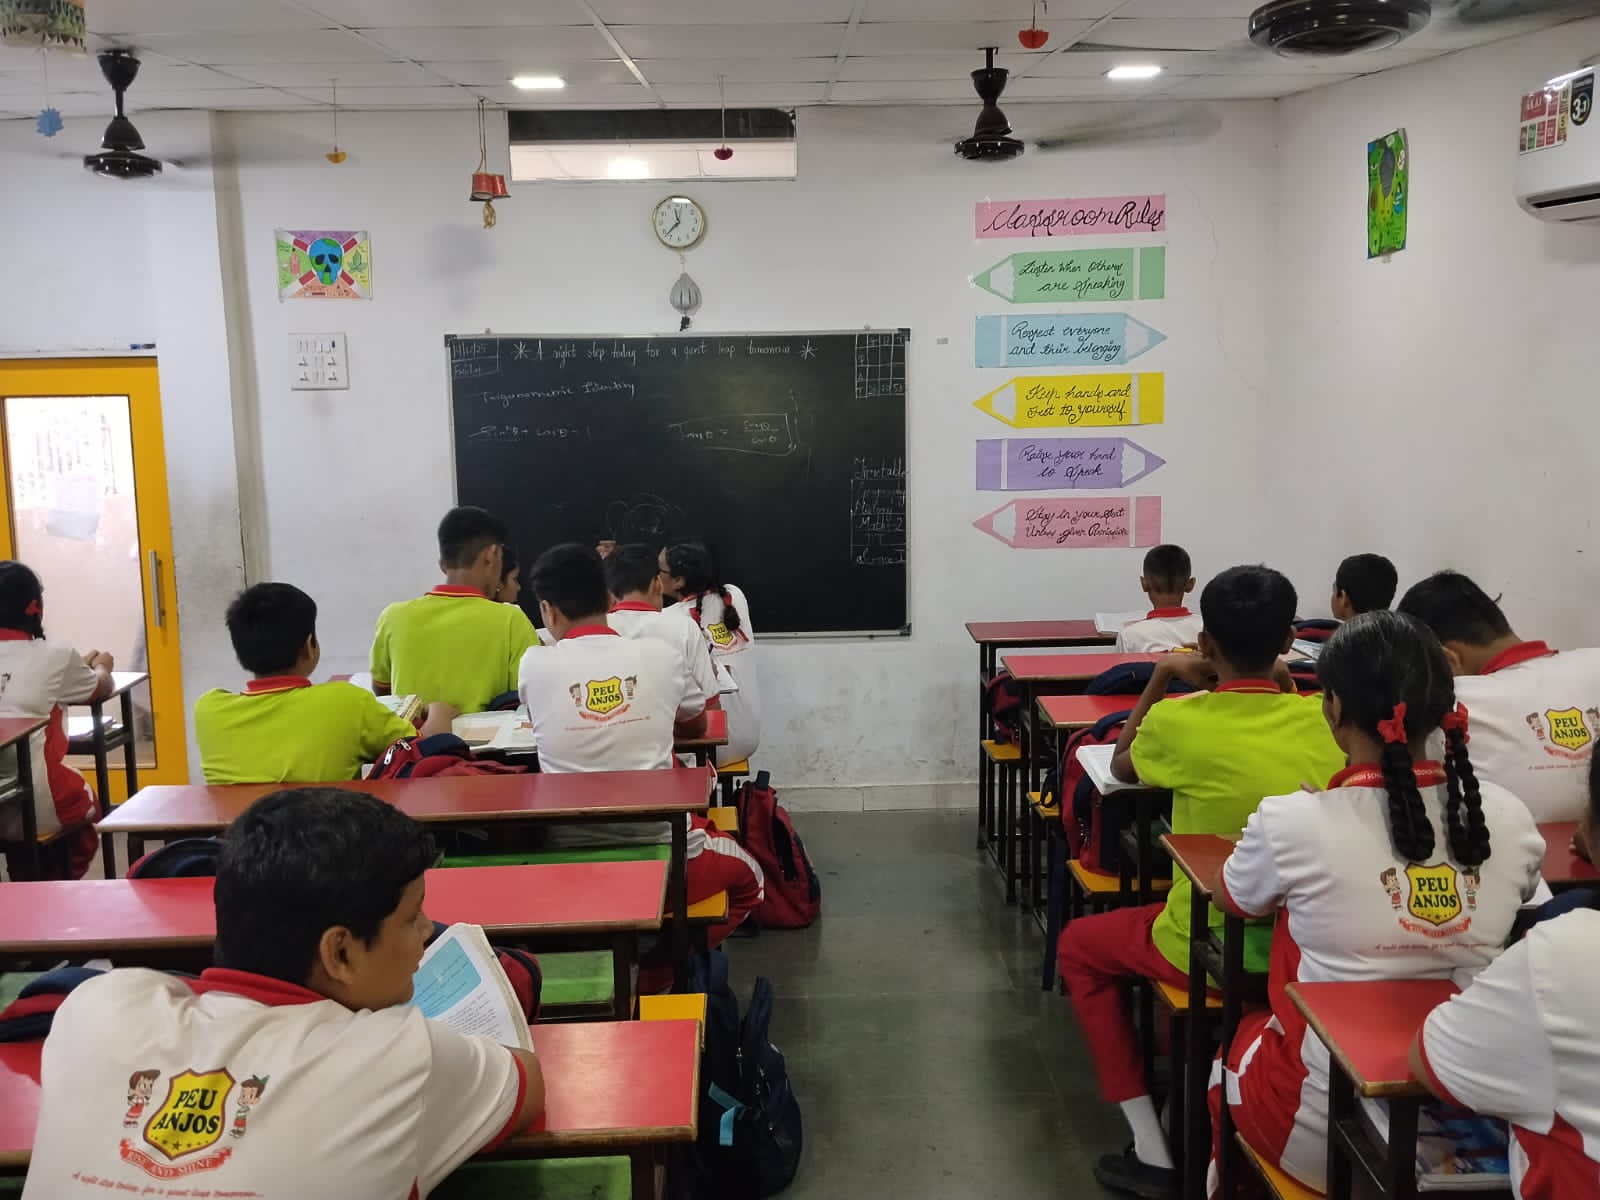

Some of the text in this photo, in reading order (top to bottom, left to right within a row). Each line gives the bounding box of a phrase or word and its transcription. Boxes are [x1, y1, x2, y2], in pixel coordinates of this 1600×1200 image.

[1037, 281, 1070, 292] are
[1012, 321, 1112, 342] Respect everyone
[611, 341, 637, 367] today
[1008, 342, 1036, 355] and
[593, 684, 616, 696] PEU
[589, 693, 621, 706] ANJOS
[1554, 716, 1578, 728] PEU
[1554, 727, 1587, 739] ANJOS
[1416, 877, 1449, 892] PEU
[1413, 894, 1457, 908] ANJOS
[173, 1088, 218, 1110] PEU
[153, 1112, 221, 1134] ANJOS
